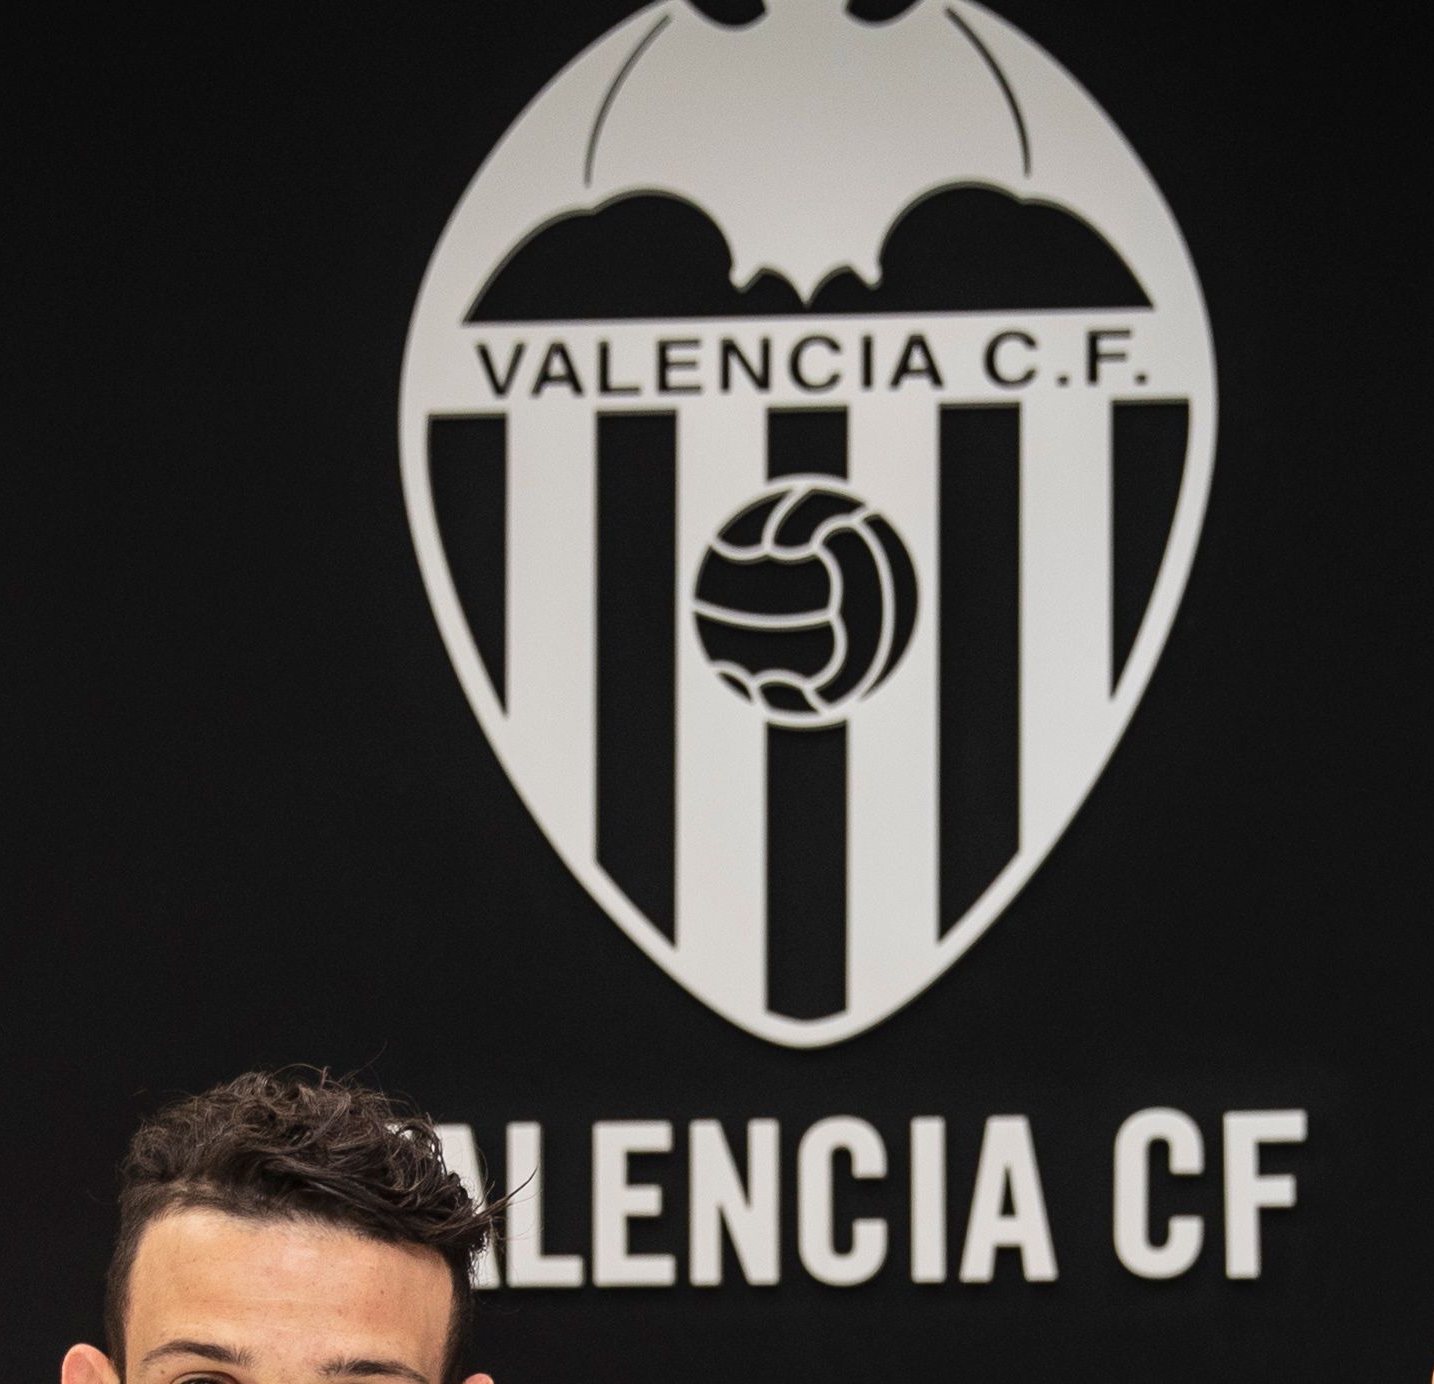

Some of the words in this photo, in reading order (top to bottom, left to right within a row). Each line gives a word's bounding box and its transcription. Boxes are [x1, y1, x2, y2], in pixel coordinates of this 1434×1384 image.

[476, 333, 945, 397] VALENCIA
[983, 329, 1148, 389] C.F.
[387, 1114, 1058, 1288] ALENCIA
[1113, 1107, 1308, 1280] CF
